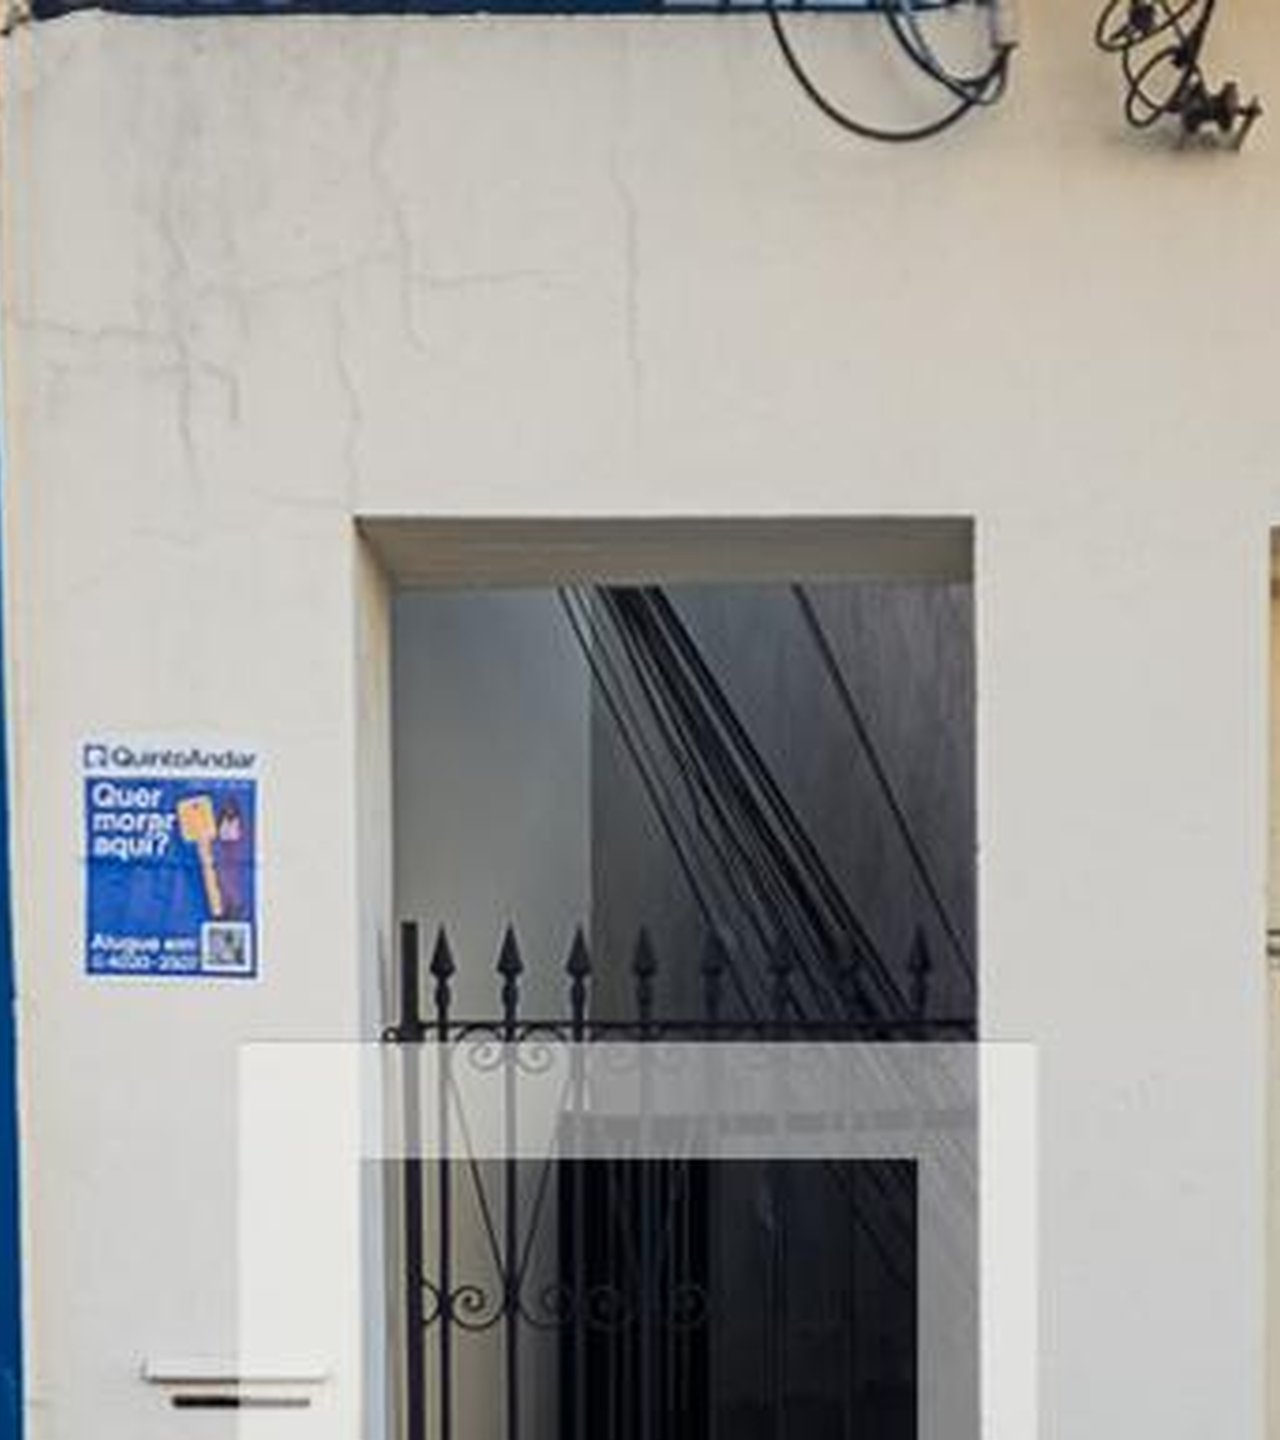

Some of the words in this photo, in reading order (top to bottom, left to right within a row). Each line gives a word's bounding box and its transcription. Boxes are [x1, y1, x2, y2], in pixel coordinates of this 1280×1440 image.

[112, 748, 255, 769] QuintoAndar
[92, 782, 163, 808] Quer
[92, 812, 176, 831] morar
[93, 833, 169, 860] aqui?
